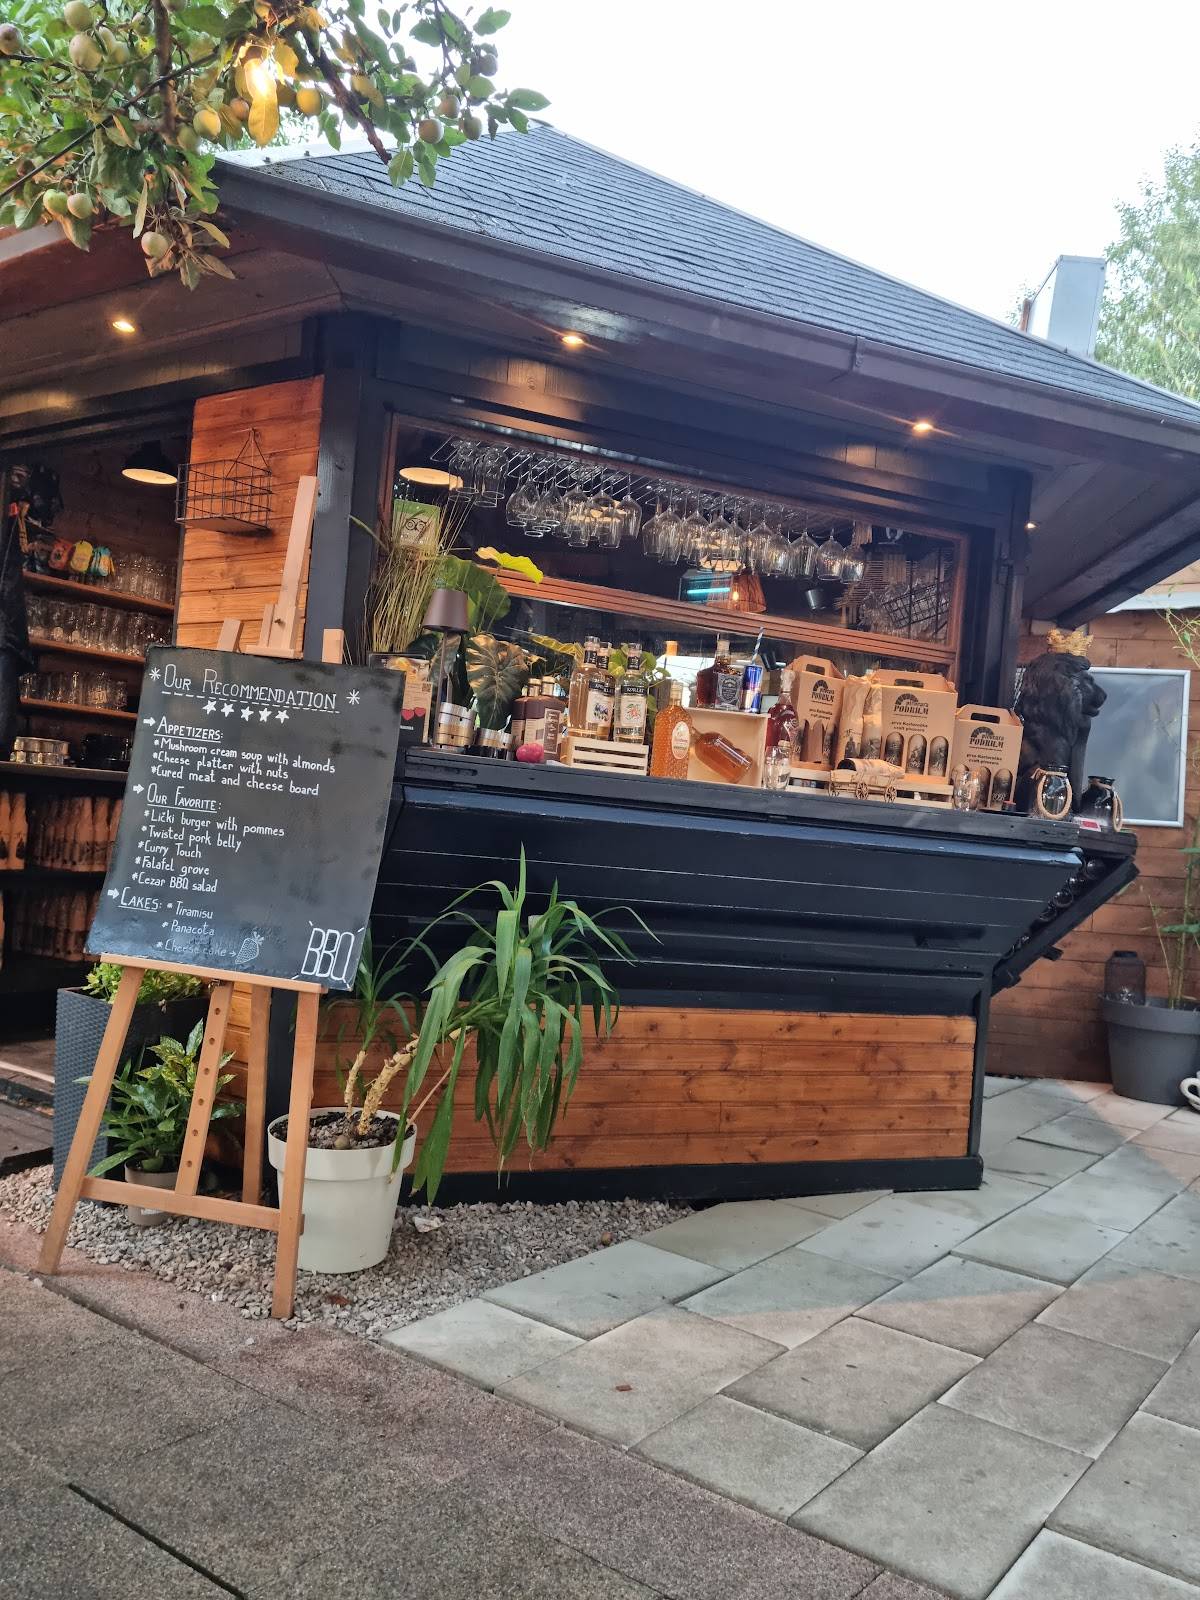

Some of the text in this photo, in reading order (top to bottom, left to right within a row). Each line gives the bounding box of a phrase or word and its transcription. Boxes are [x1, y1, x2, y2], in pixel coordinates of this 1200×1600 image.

[157, 750, 288, 780] Cheese platter with nuts
[160, 737, 336, 774] Mushroom cream soup with almonds
[156, 764, 320, 796] Cured meat and cheese board
[151, 810, 285, 837] Lički burger with pommes
[144, 840, 202, 859] Curry Touch
[149, 824, 242, 853] Twisted pork belly
[141, 855, 210, 877] Falafel grove
[138, 871, 218, 893] Cezar BBQ salad
[175, 900, 214, 919] Tiramisu
[170, 919, 215, 936] Panacota
